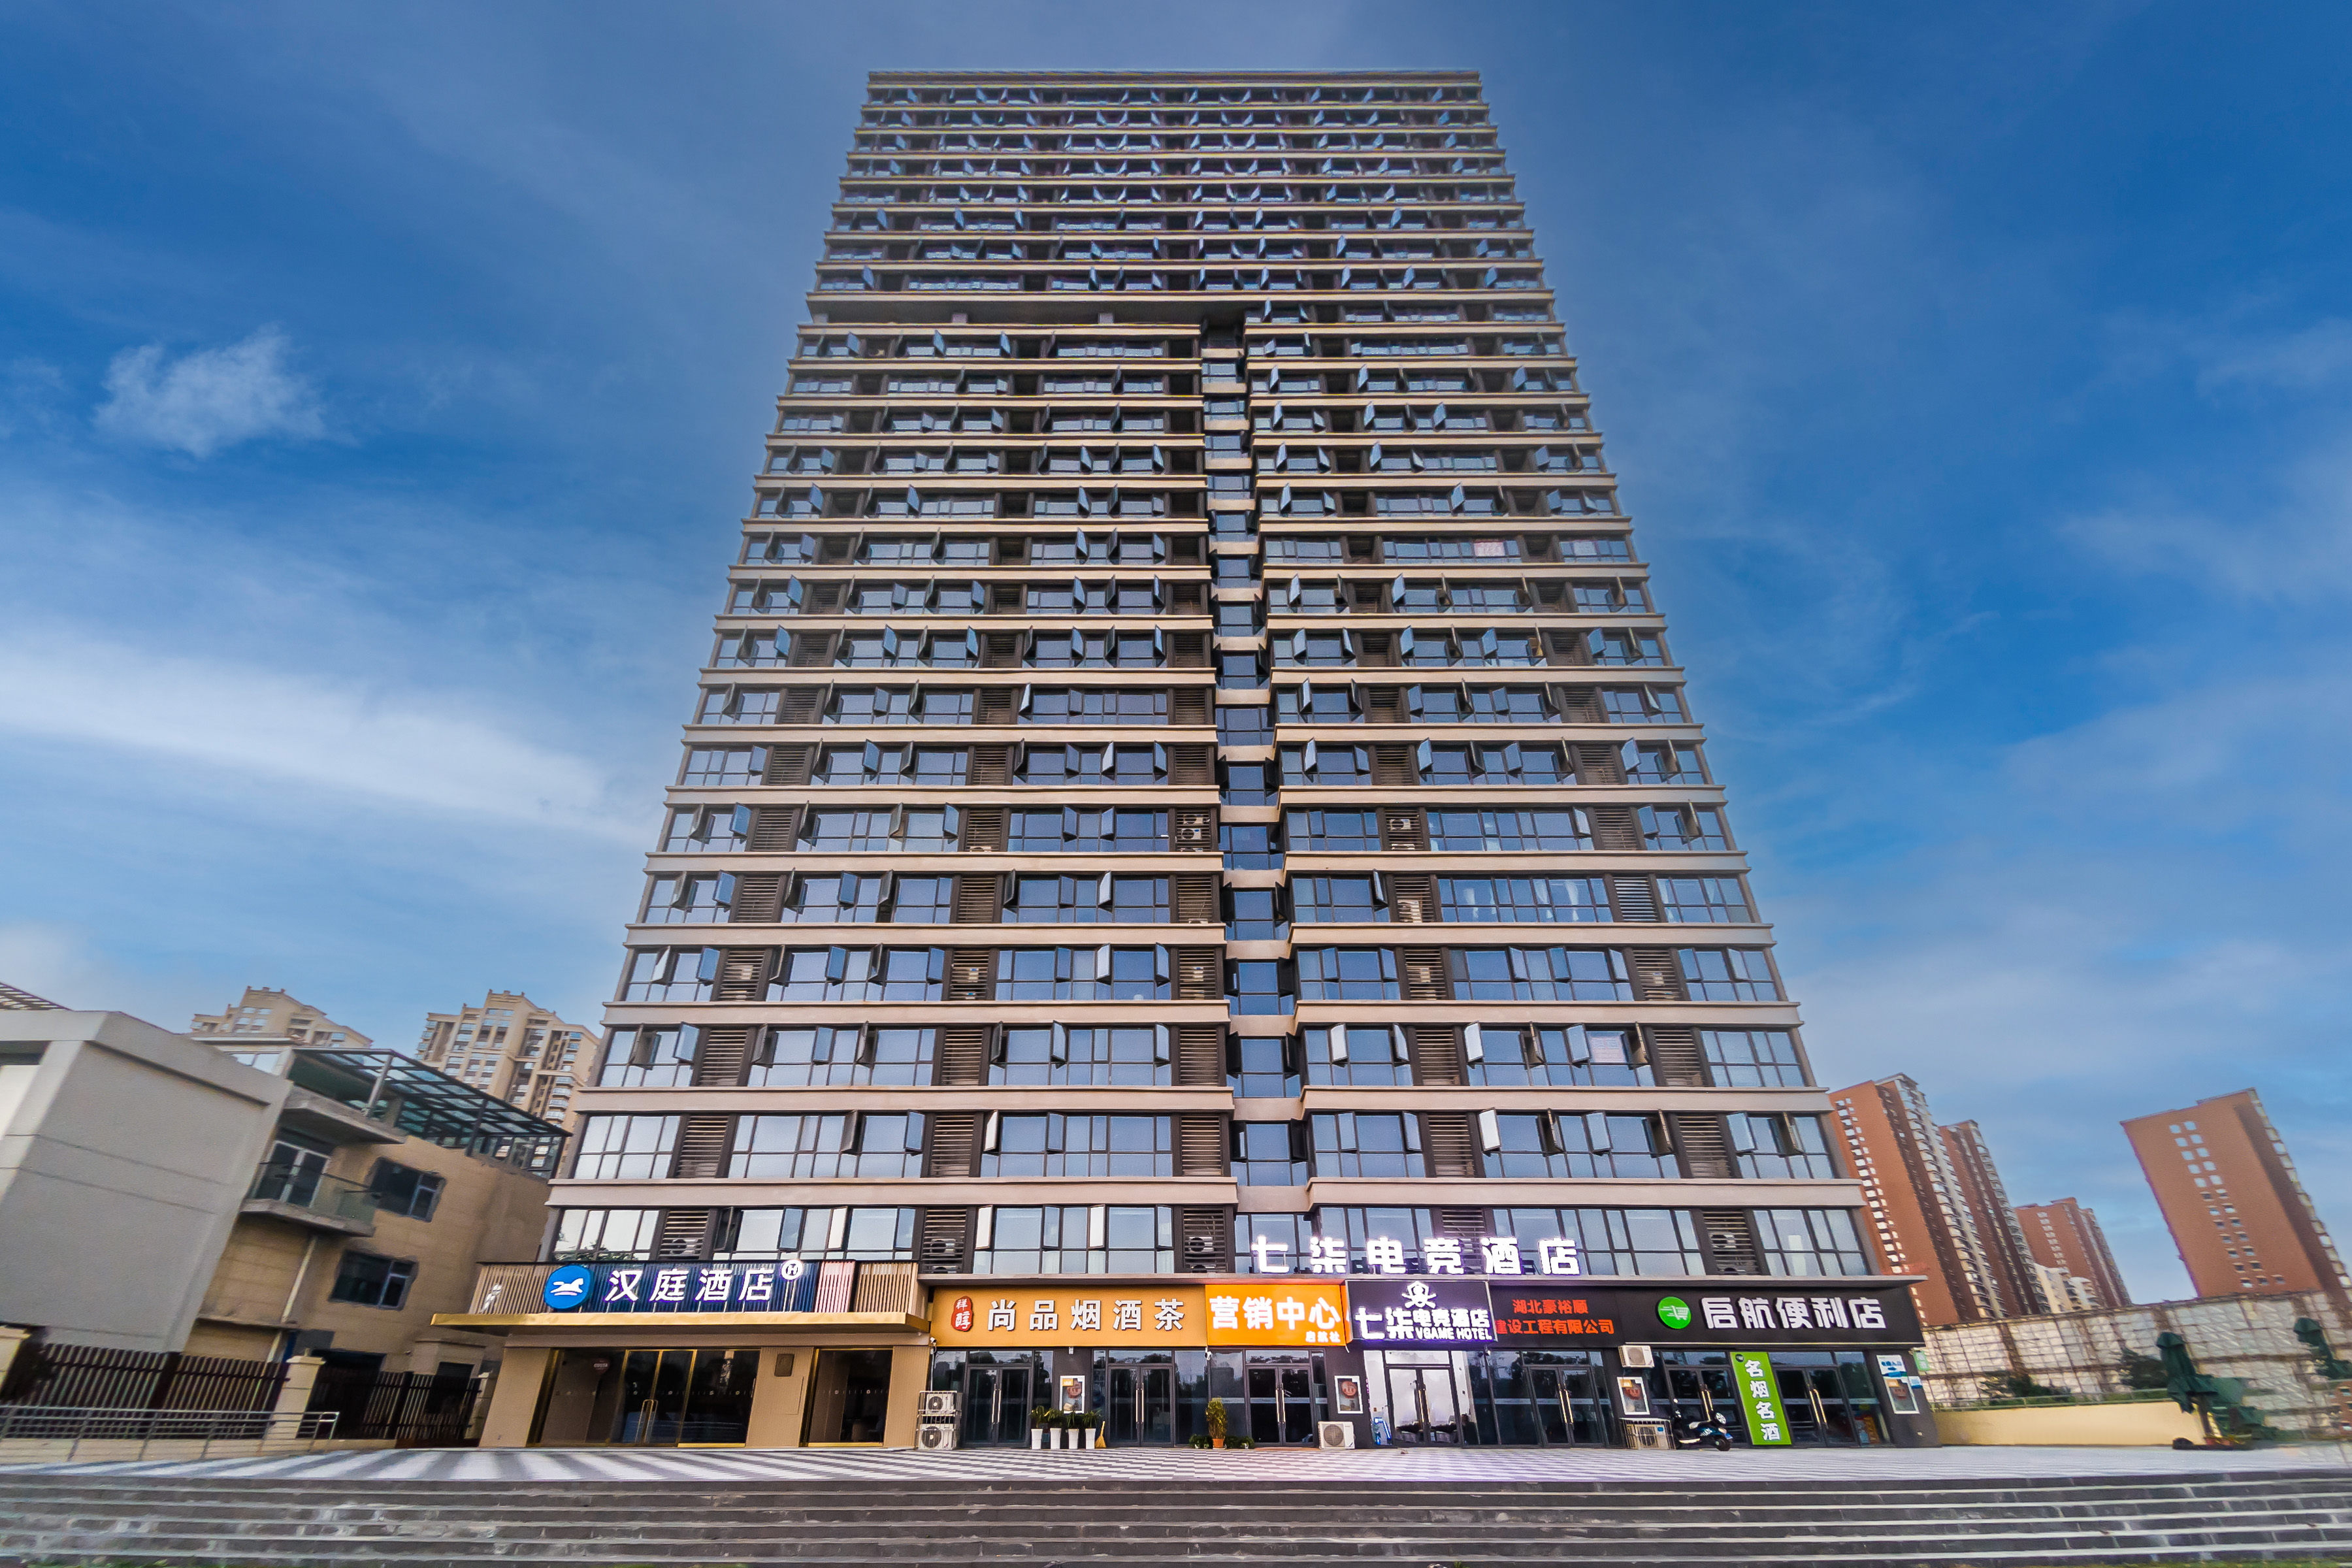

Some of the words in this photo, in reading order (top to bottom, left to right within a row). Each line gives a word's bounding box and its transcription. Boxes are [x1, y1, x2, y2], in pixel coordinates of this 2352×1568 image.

[1251, 1235, 1580, 1275] 七柒电竞酒店
[604, 1268, 776, 1303] 汉庭酒店
[955, 1298, 971, 1330] 祥醇
[987, 1298, 1185, 1331] 尚品烟酒茶
[1209, 1296, 1341, 1330] 营销中心
[1512, 1299, 1588, 1315] 湖北豪裕顺
[1701, 1296, 1887, 1330] 启航便利店
[1456, 1327, 1492, 1340] HOTEL
[1495, 1319, 1614, 1335] 建设工程有限公司
[1744, 1360, 1780, 1441] 名烟名酒
